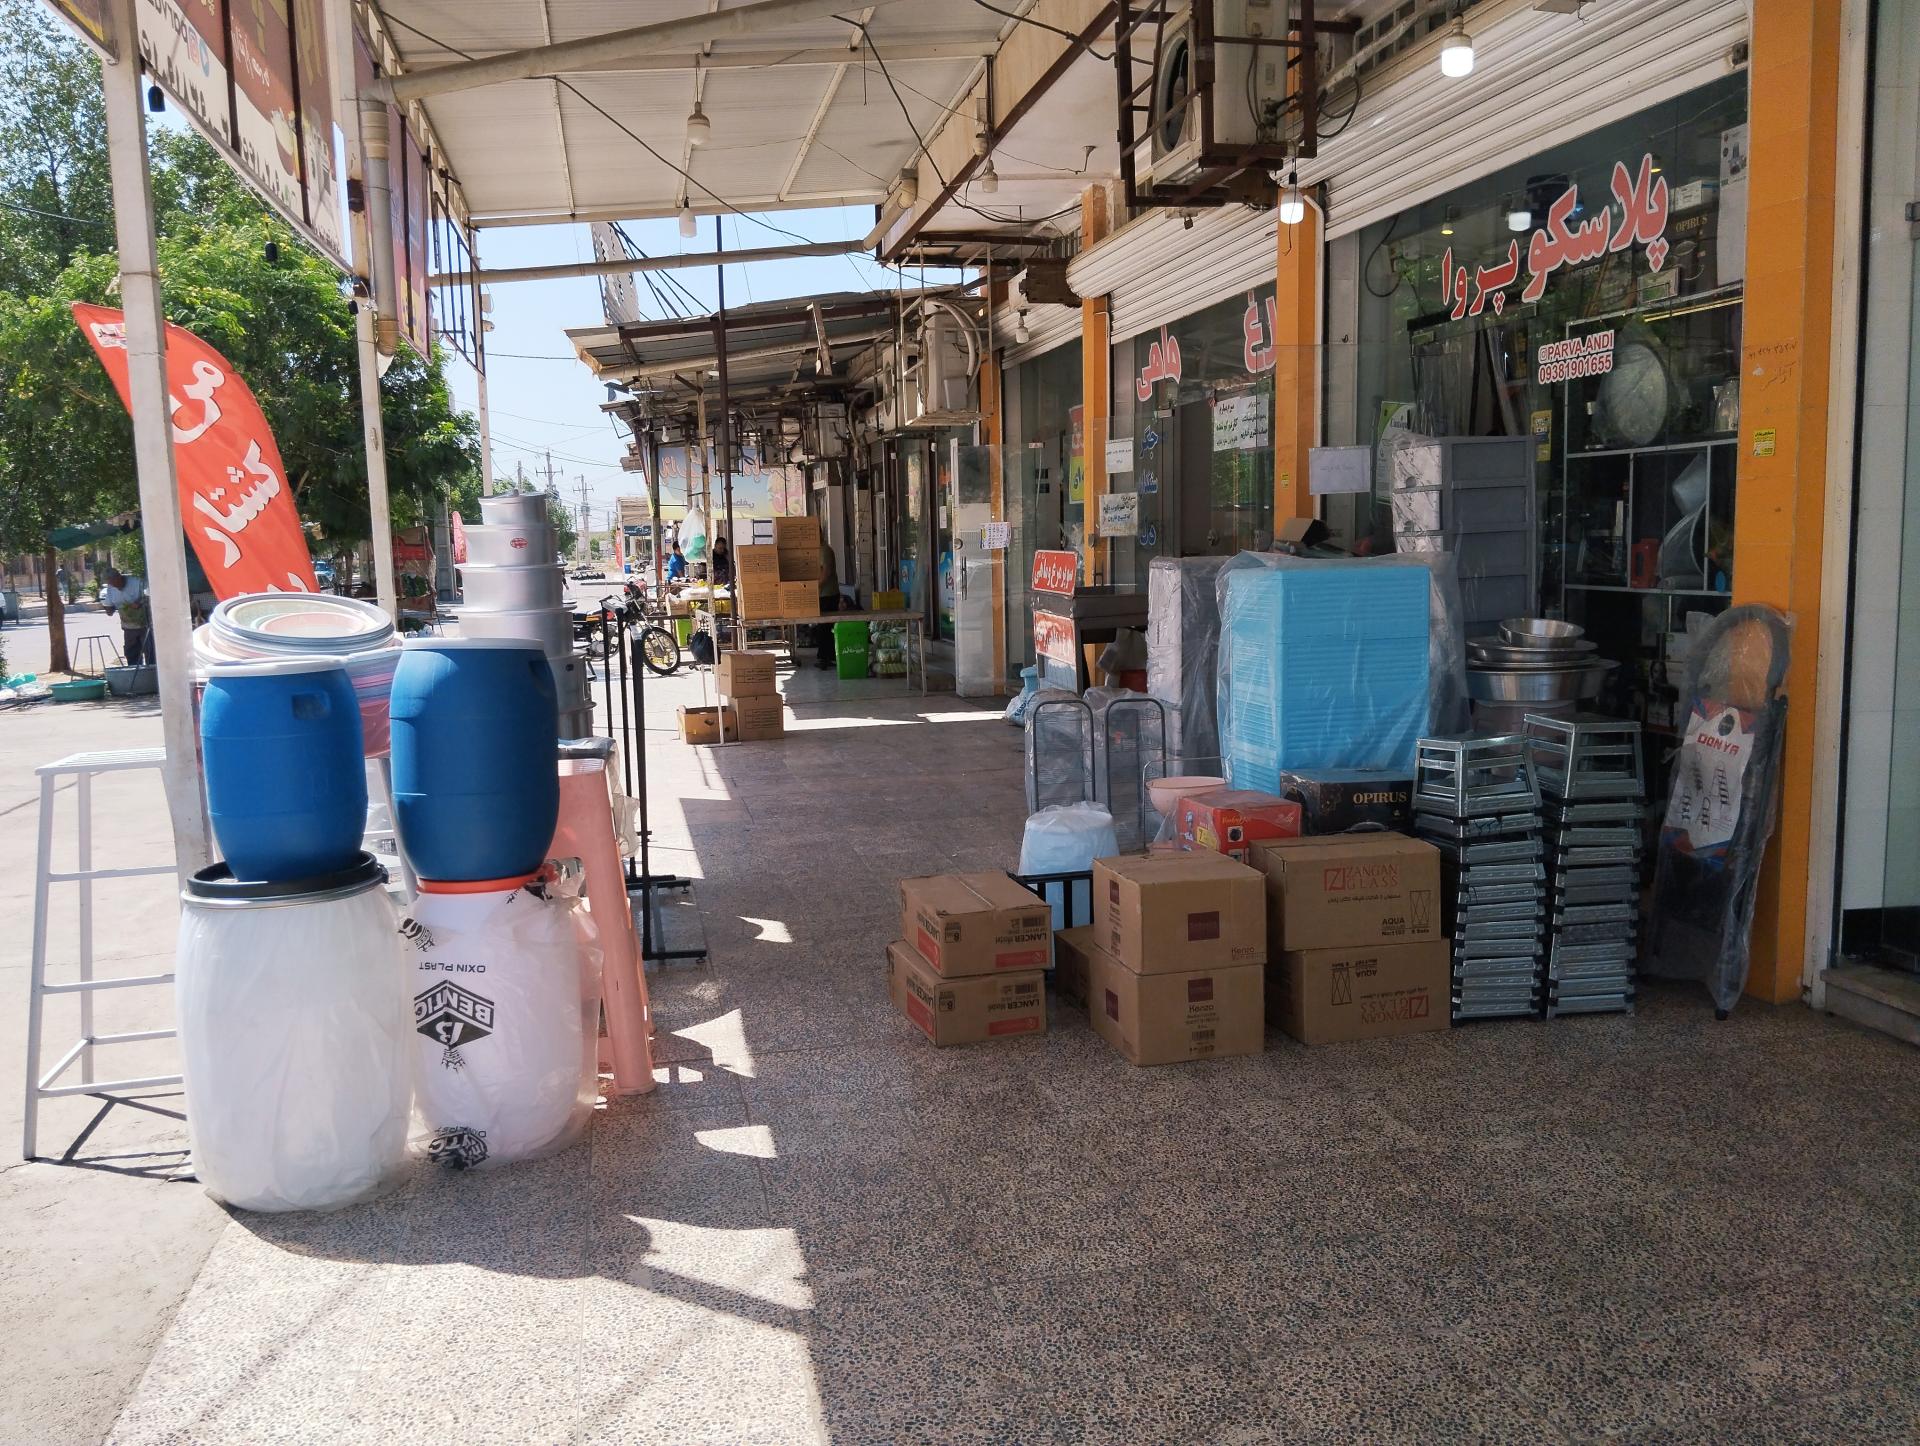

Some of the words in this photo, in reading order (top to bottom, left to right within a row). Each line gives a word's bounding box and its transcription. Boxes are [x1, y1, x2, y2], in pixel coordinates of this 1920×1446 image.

[1675, 215, 1708, 233] OPIRUS
[1442, 238, 1519, 321] پروا
[1539, 331, 1614, 363] @PARVA.ANDI
[1136, 325, 1182, 402] ماهی
[1539, 353, 1612, 383] 09381901655
[193, 438, 281, 569] کشتار
[1353, 791, 1407, 804] OPIRUS
[1346, 863, 1398, 877] ZANGAN
[1347, 877, 1398, 890] GLASS
[1382, 917, 1405, 926] AQUA
[1015, 932, 1047, 943] LANCER
[1231, 945, 1255, 953] Kenzo
[419, 962, 454, 972] PLAST
[456, 962, 486, 973] OXIN
[1356, 969, 1377, 978] AQUA
[1007, 998, 1040, 1010] LANCER
[1189, 1004, 1214, 1012] Kenzo
[1361, 998, 1409, 1012] GLASS
[1362, 1008, 1409, 1024] ZANGAN
